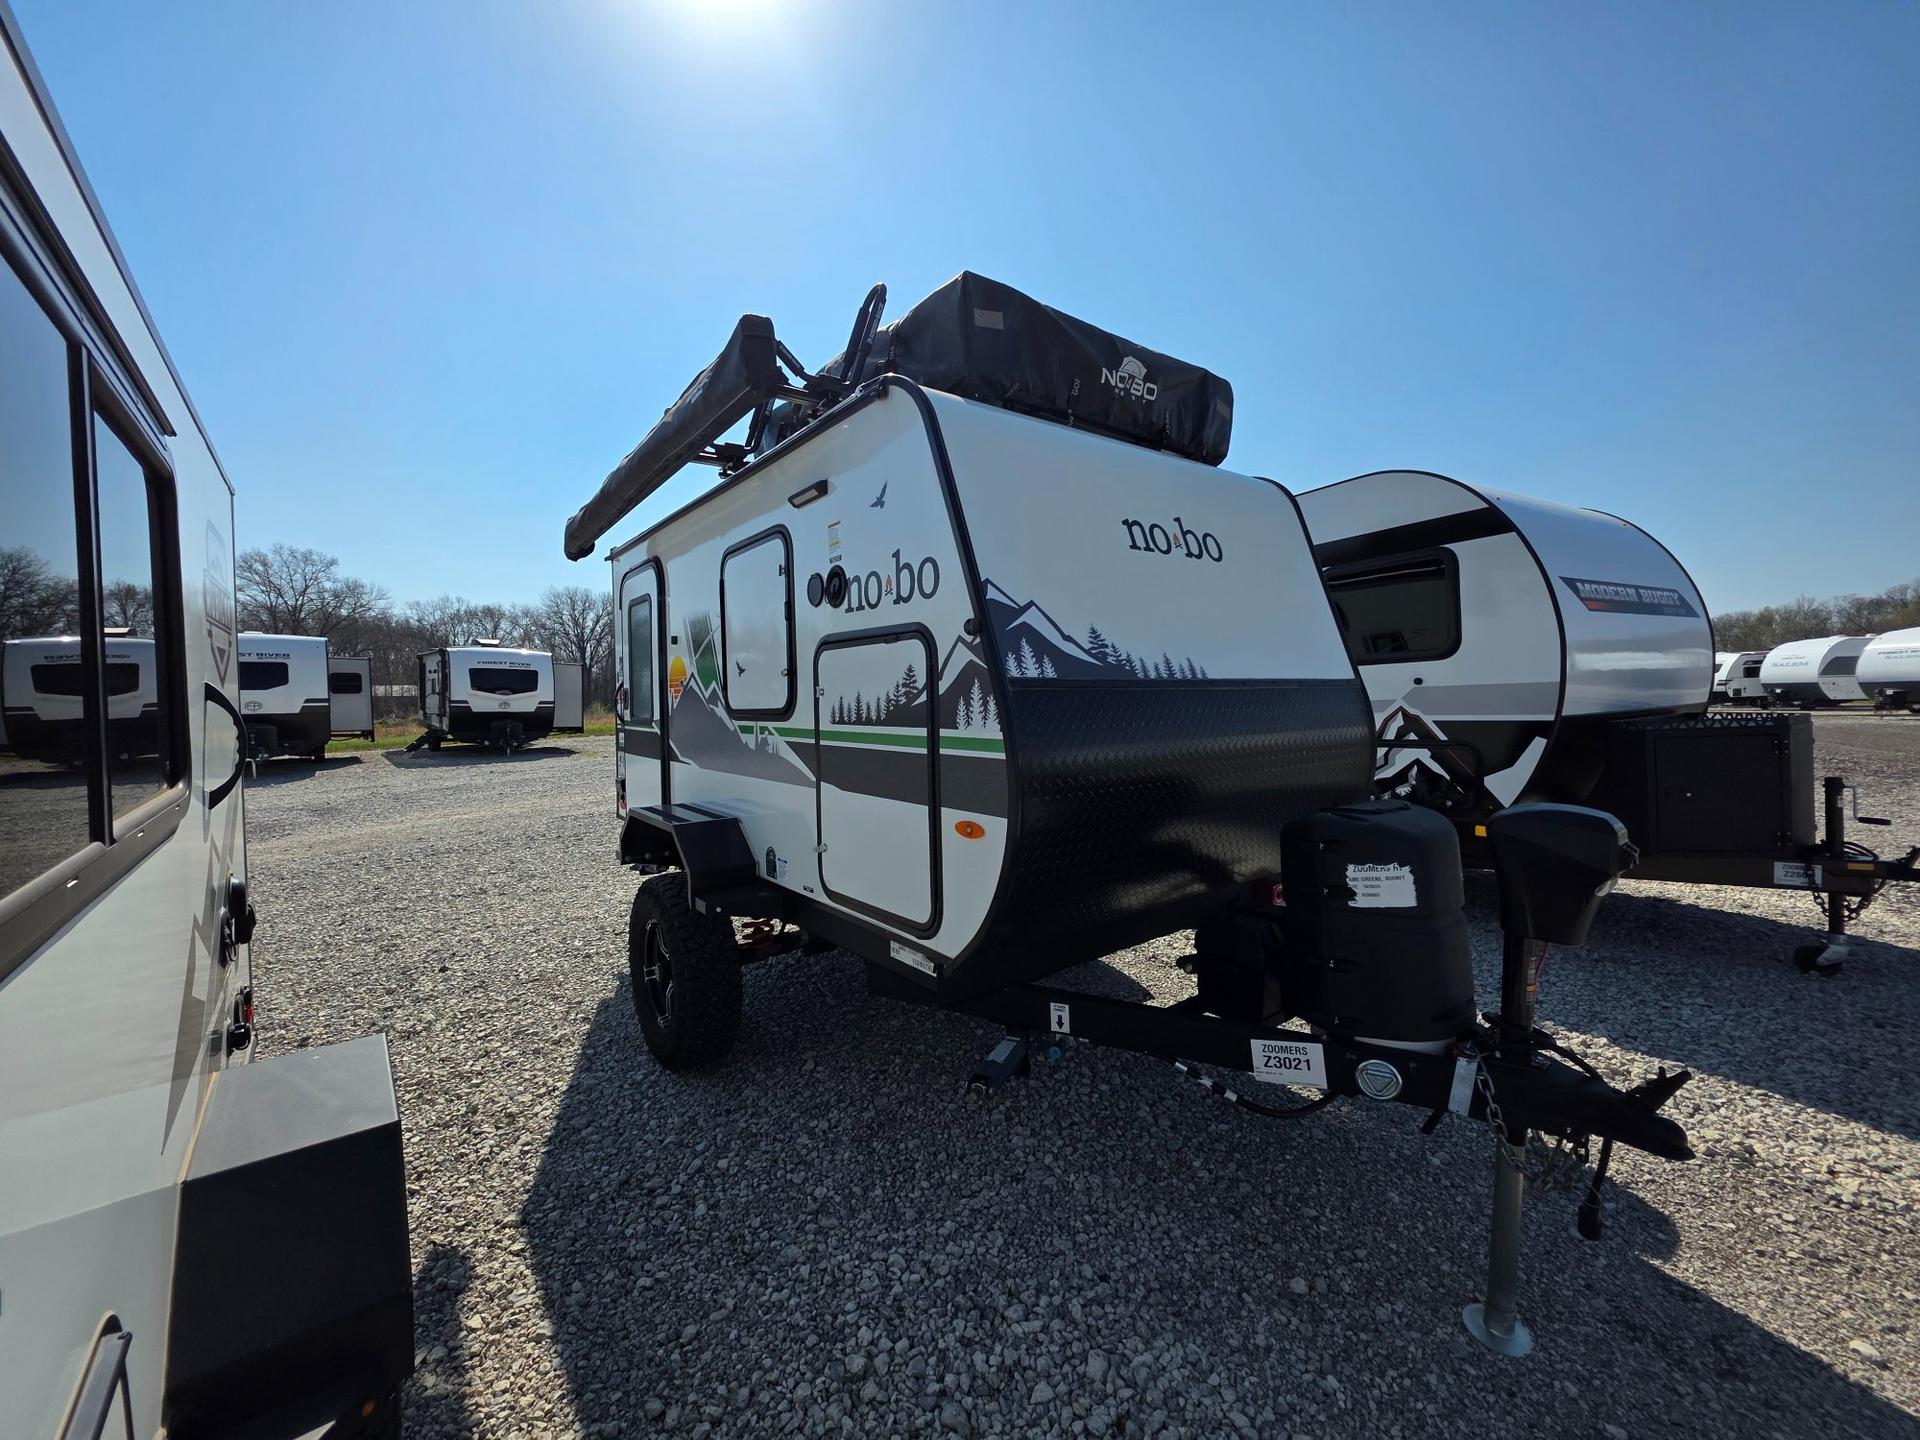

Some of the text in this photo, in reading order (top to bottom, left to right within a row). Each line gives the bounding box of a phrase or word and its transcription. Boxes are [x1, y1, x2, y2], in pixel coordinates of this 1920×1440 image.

[1575, 582, 1680, 606] MODERN BUGGY
[1261, 1043, 1308, 1056] ZOOMERS
[1262, 1055, 1311, 1072] Z3021
